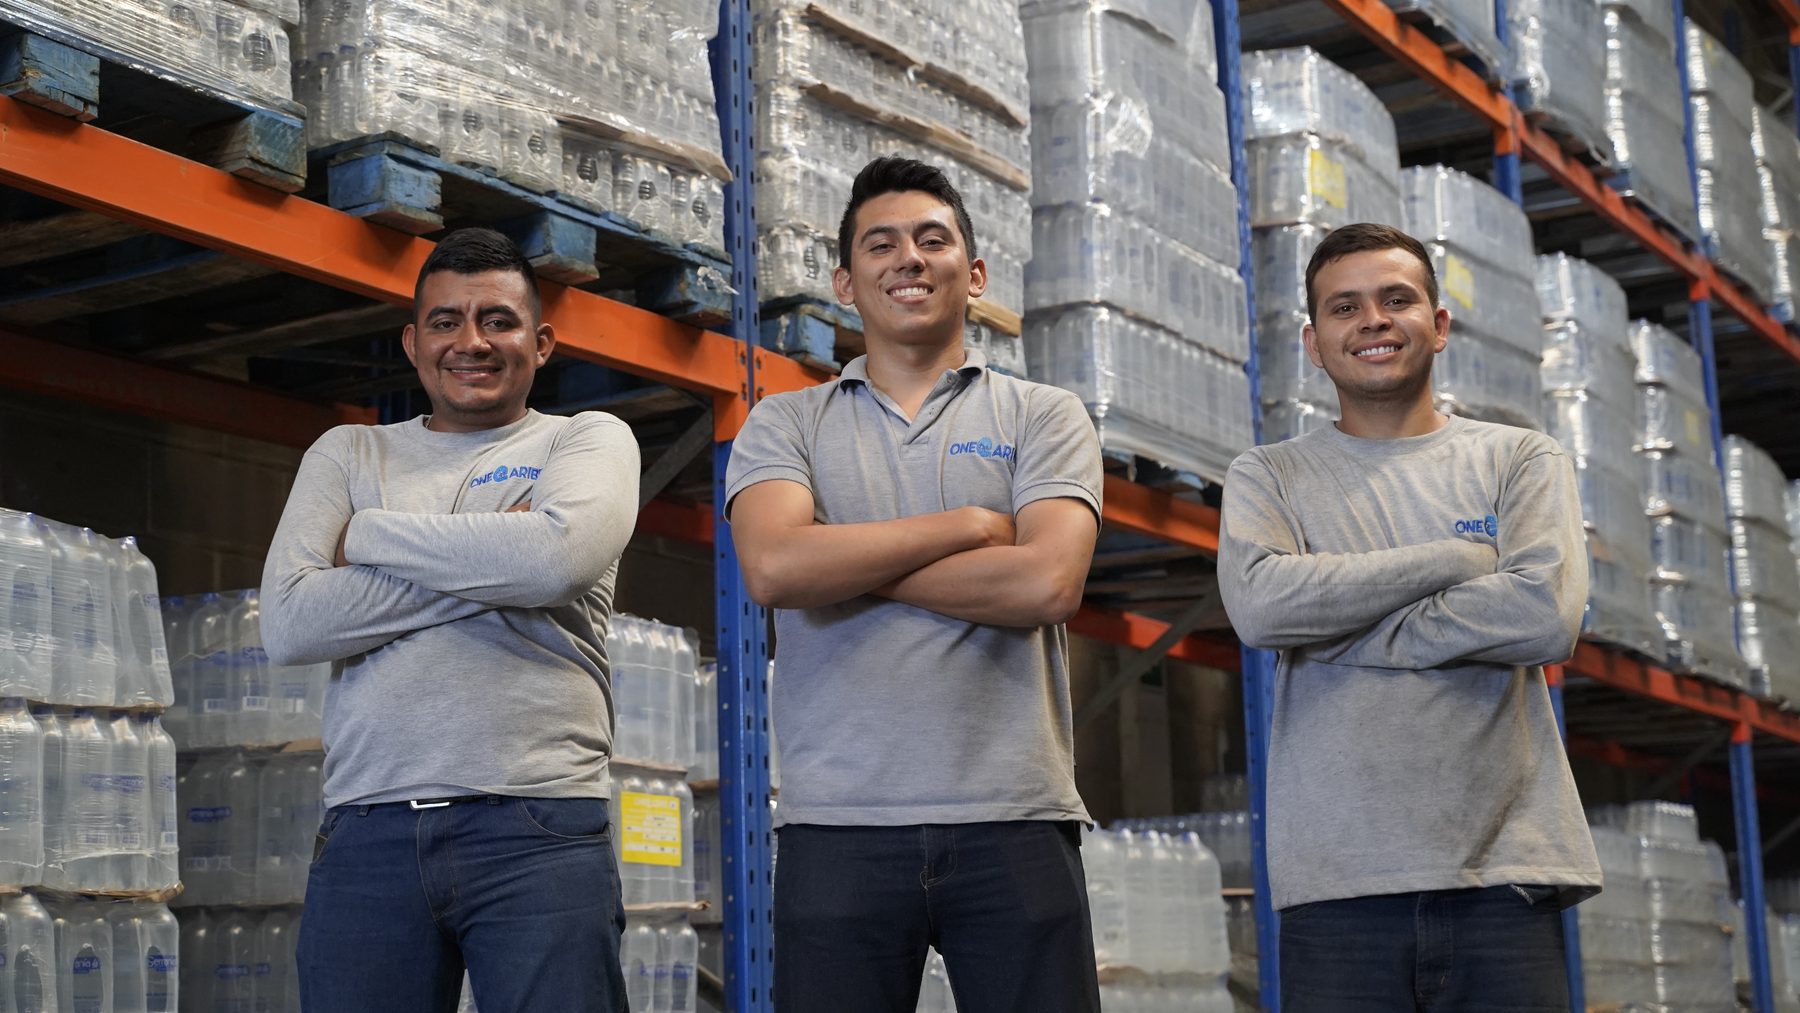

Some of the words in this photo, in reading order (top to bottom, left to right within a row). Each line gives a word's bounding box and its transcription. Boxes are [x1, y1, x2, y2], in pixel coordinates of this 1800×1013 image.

[950, 441, 977, 455] ONE
[470, 471, 493, 488] ONE
[1455, 519, 1484, 534] ONE
